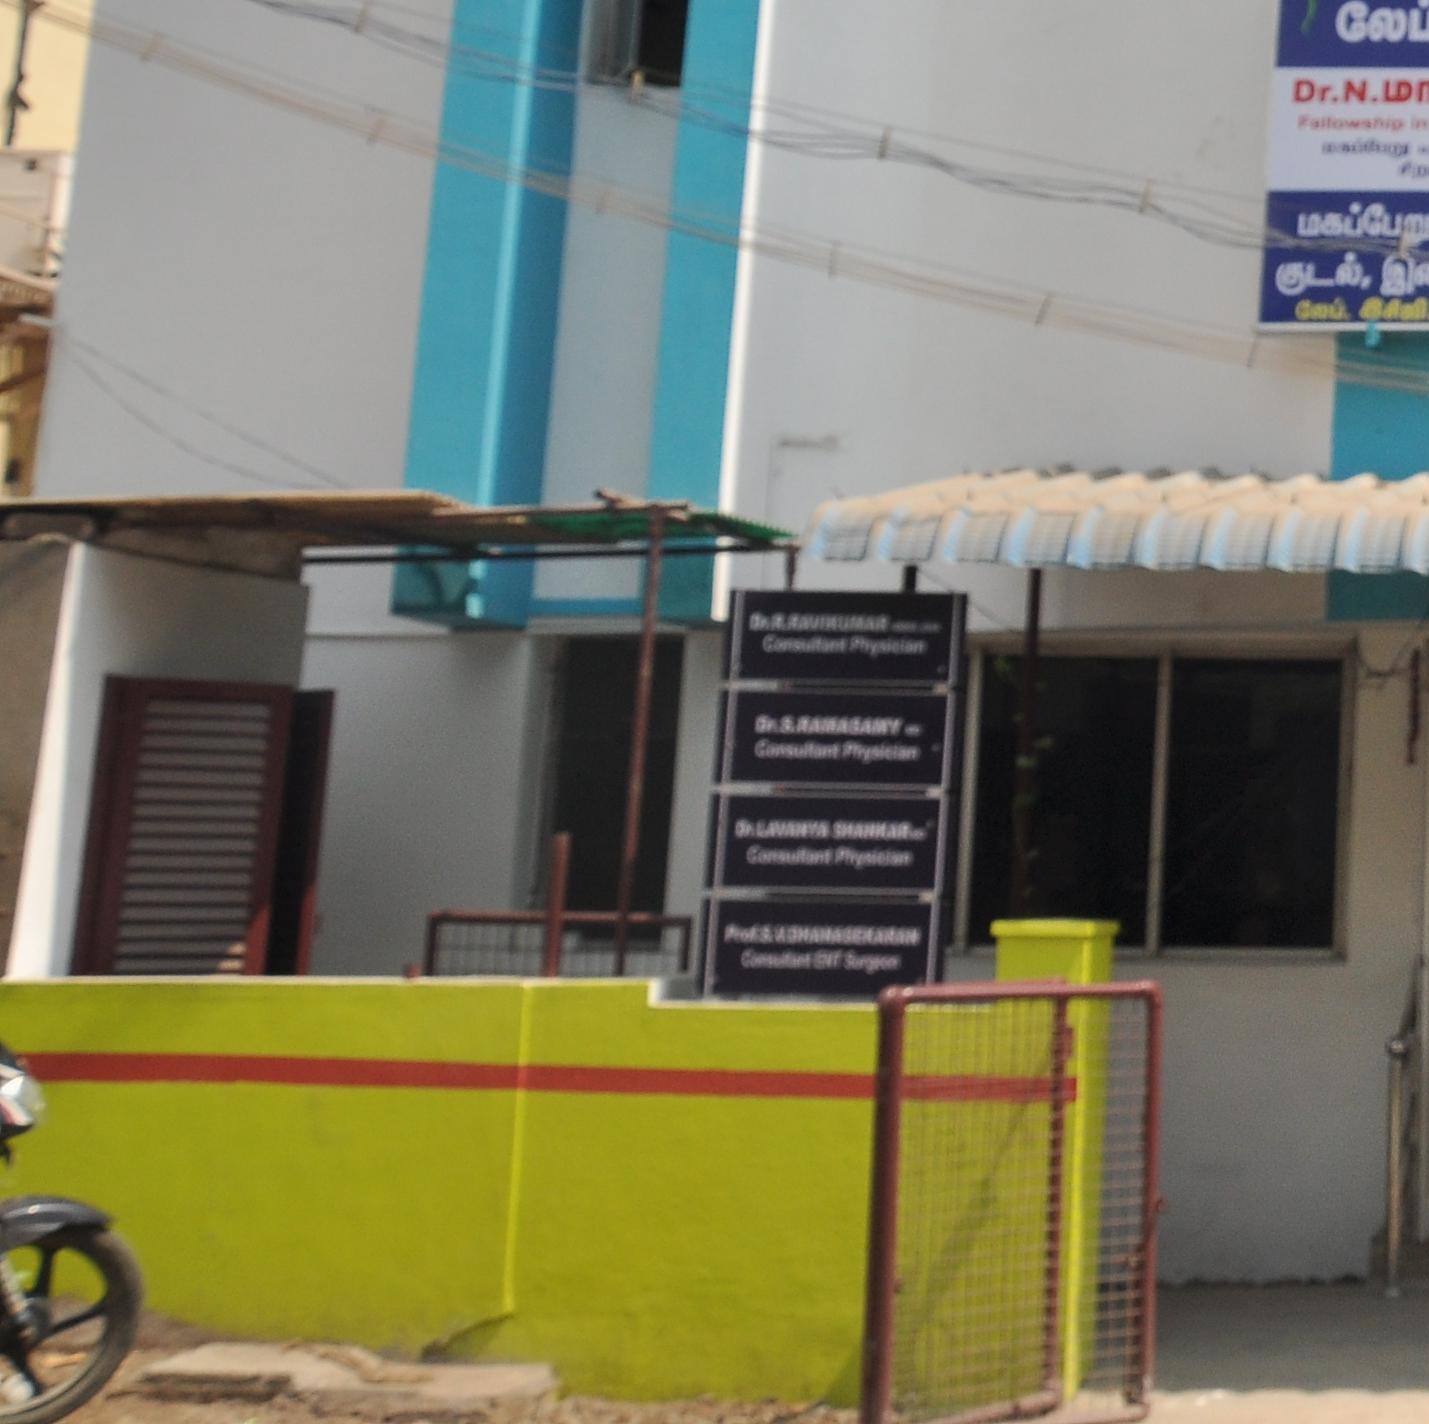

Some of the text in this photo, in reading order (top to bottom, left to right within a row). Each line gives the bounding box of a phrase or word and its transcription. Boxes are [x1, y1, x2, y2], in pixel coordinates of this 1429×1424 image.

[1297, 116, 1401, 132] Fellowship
[1410, 117, 1428, 130] in
[1275, 251, 1372, 294] குடல்,
[762, 634, 928, 659] Consultant Physician
[754, 739, 920, 764] Consultant Physician
[746, 845, 913, 869] Consultant Physician
[740, 949, 814, 969] Consultant
[843, 950, 899, 972] Surgeon
